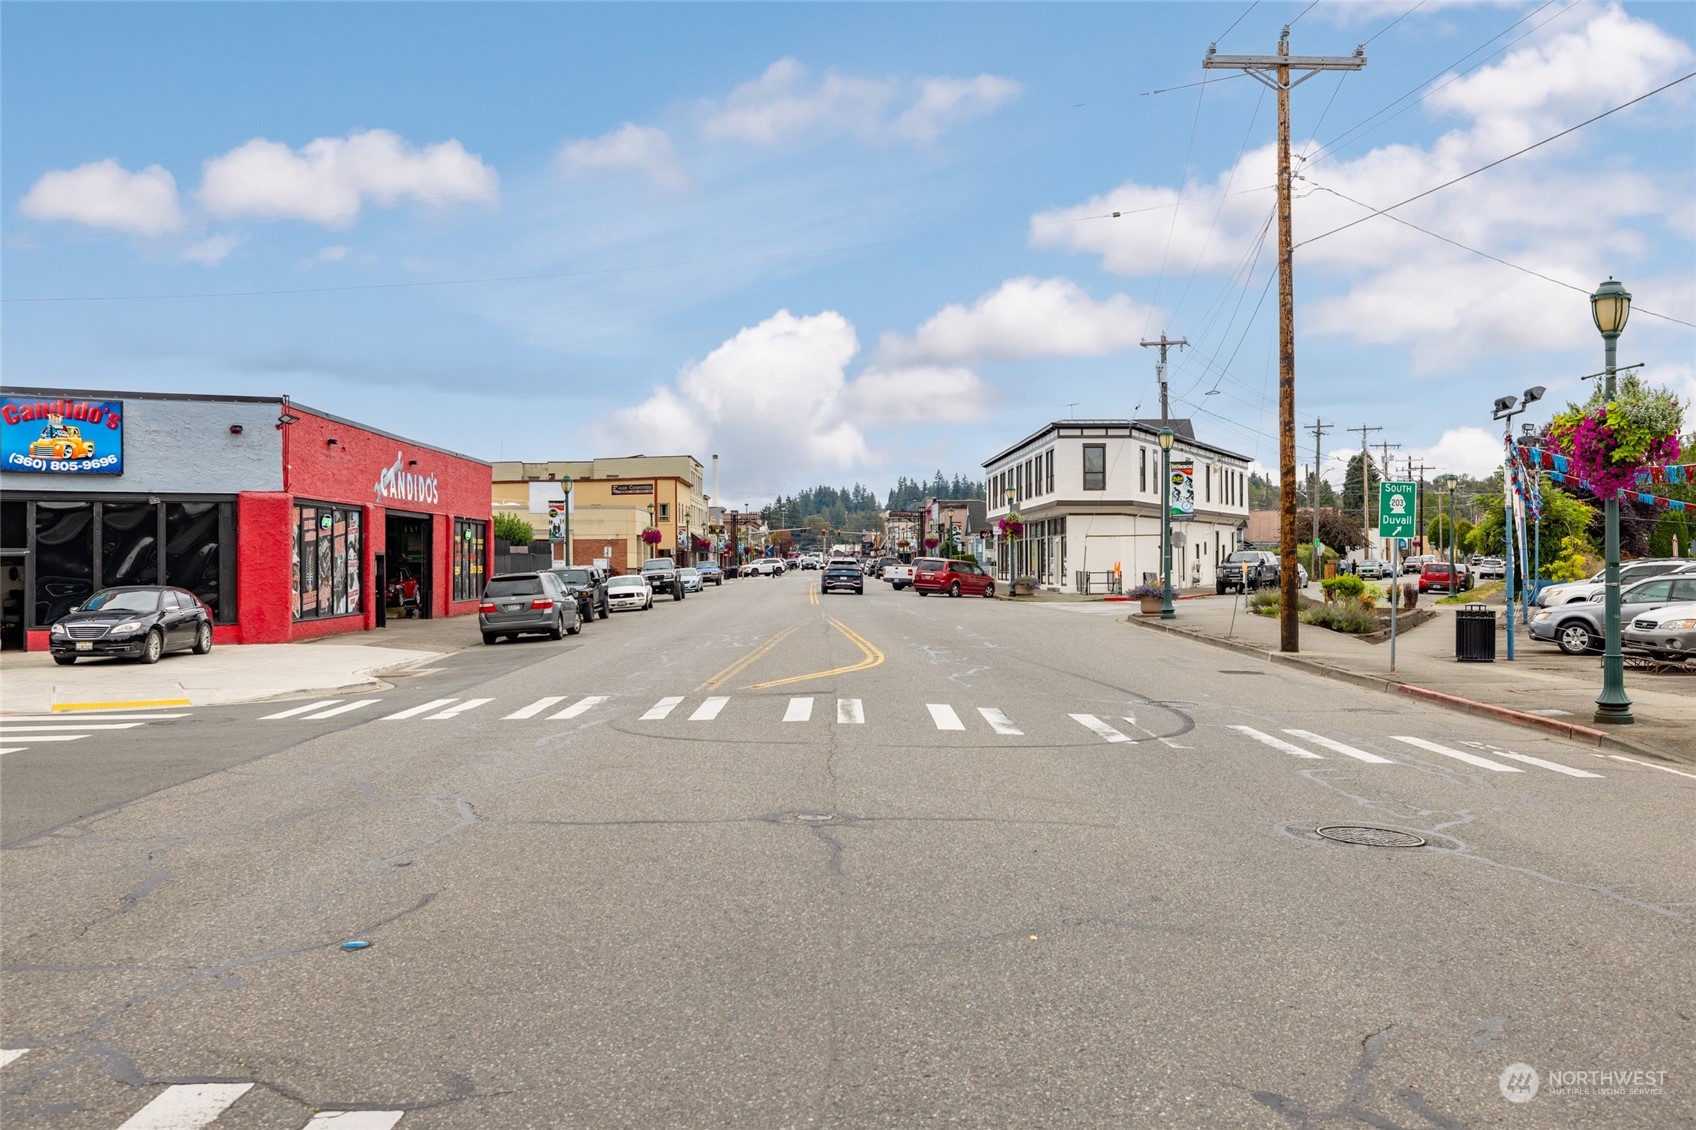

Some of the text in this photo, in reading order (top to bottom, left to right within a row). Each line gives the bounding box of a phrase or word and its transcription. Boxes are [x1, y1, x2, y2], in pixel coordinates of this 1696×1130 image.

[1, 399, 121, 430] Candido's
[9, 453, 118, 471] (360) 805-9696
[380, 467, 438, 504] CANDIDO'S
[1385, 483, 1412, 492] SOUTH
[1391, 499, 1404, 507] 203
[1383, 515, 1412, 524] Duvall
